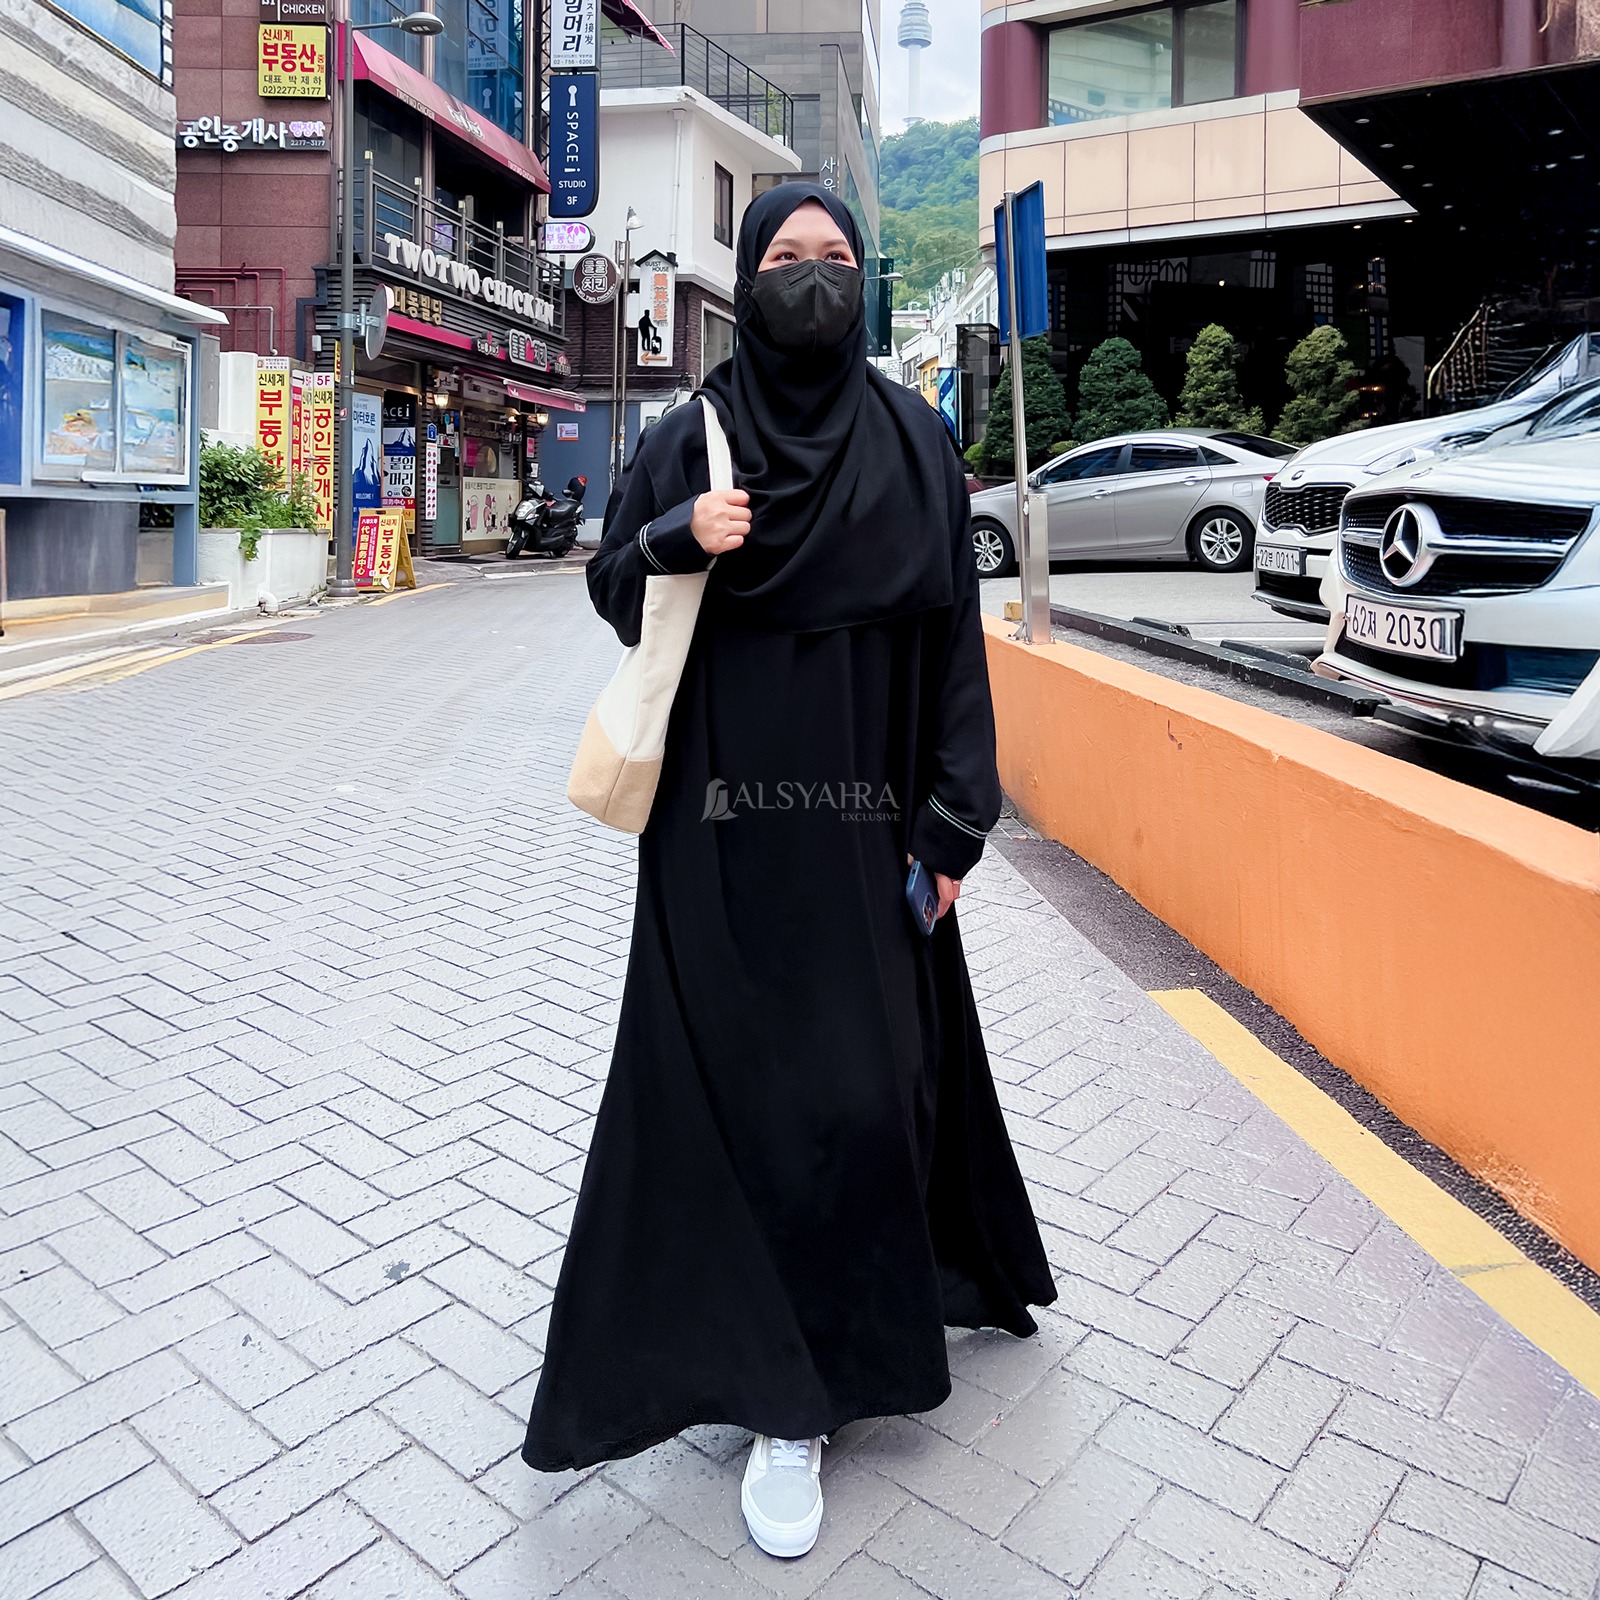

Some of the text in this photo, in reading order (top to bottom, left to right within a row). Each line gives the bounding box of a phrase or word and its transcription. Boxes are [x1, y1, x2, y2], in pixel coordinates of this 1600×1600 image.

[281, 4, 325, 15] CHICKEN
[262, 29, 294, 41] 신세계
[262, 43, 317, 73] 부동산
[317, 54, 325, 74] 중개
[263, 75, 282, 84] 대표
[262, 85, 322, 96] 02)2277-3177
[179, 115, 289, 152] 공인중개사
[289, 120, 326, 138] 행정사
[566, 111, 579, 163] SPACE
[558, 179, 587, 189] STUDIO
[566, 195, 578, 206] 3F
[546, 233, 576, 245] 부동산
[583, 258, 607, 275] 둘둘
[583, 277, 607, 292] 치킨
[393, 286, 443, 326] 대동빌딩
[482, 276, 555, 327] CHICKEN
[258, 373, 286, 387] 신세계
[316, 375, 331, 386] 5F
[313, 390, 333, 405] 신세계
[313, 408, 333, 522] 공인중개사
[390, 456, 414, 470] 붙임
[389, 472, 414, 486] 머리
[378, 529, 394, 575] 부동산
[1275, 551, 1296, 571] 0211
[1352, 603, 1377, 639] 62저
